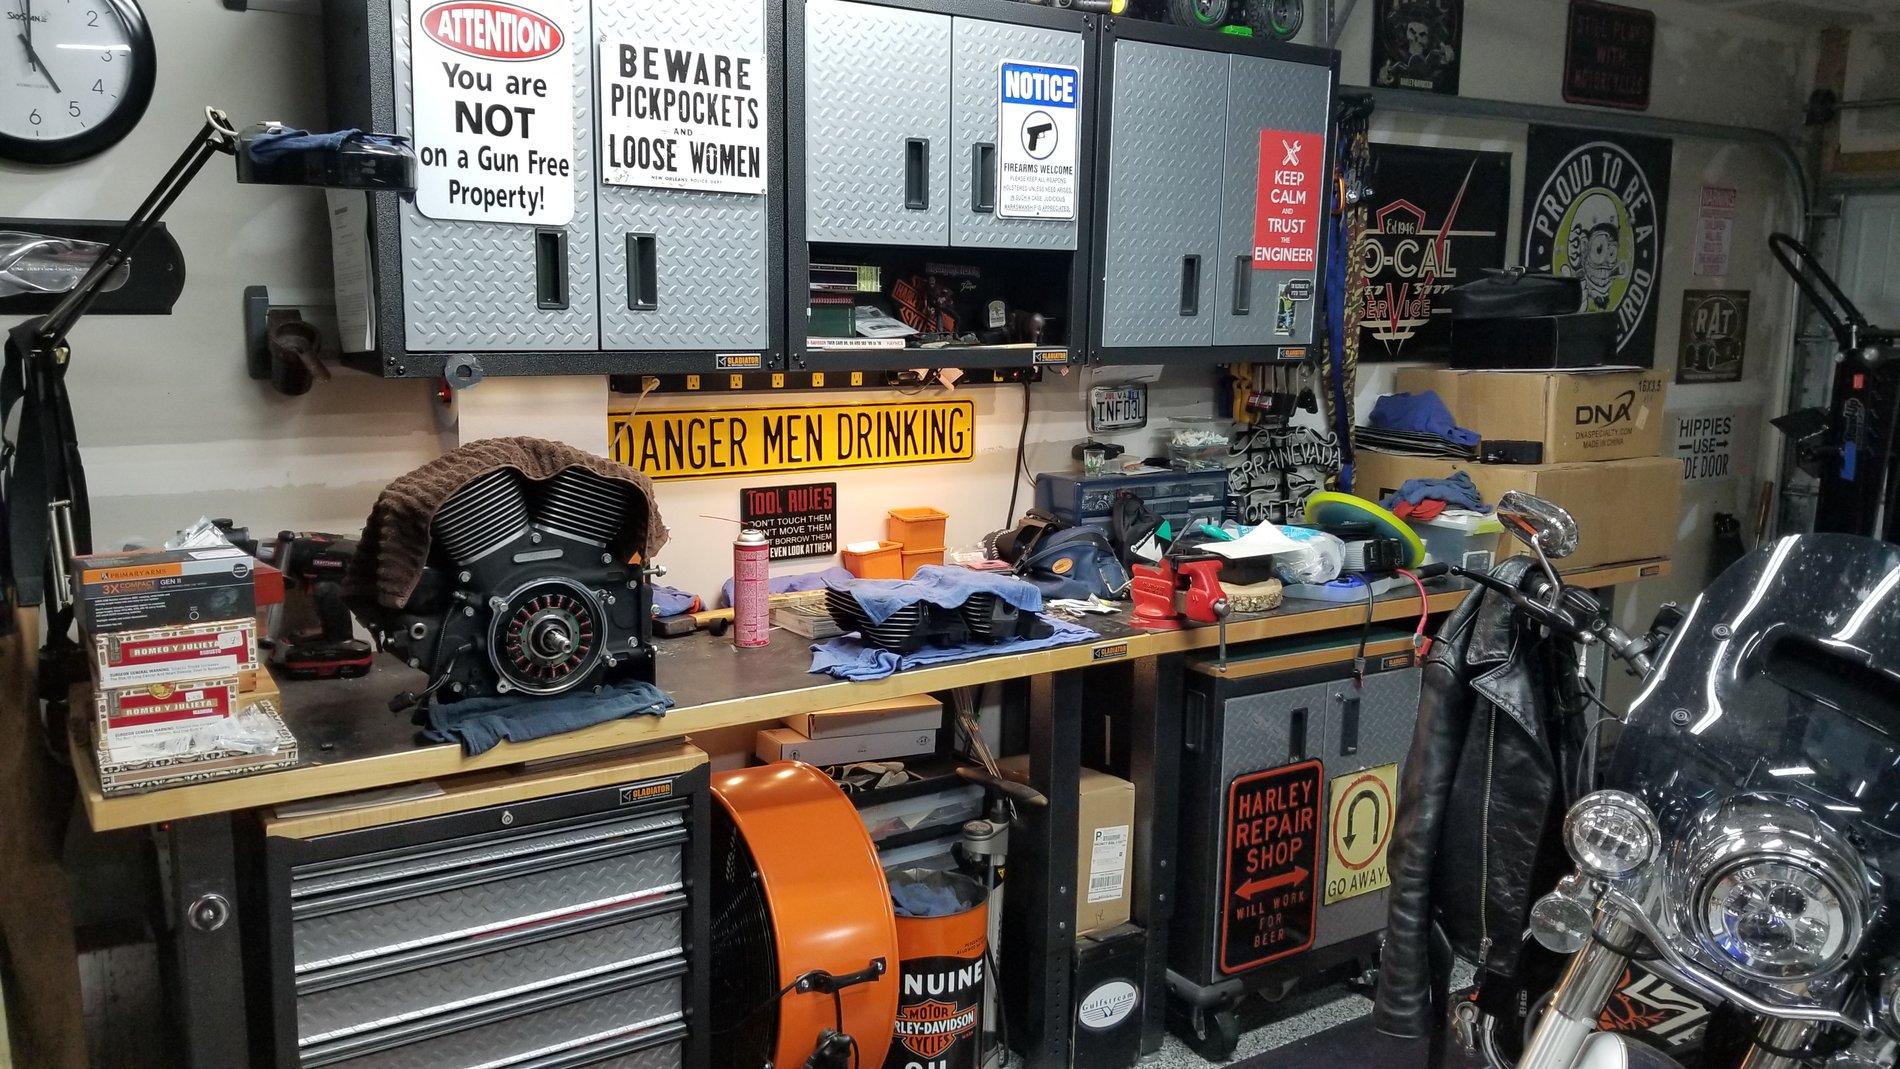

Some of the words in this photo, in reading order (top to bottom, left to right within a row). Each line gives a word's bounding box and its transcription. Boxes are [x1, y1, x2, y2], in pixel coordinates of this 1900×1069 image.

[86, 10, 99, 27] 2
[437, 7, 551, 52] ATTENTION
[619, 44, 751, 91] BEWARE
[92, 78, 104, 94] 4
[442, 62, 492, 92] You
[507, 75, 547, 98] are
[1005, 70, 1074, 103] NOTICE
[29, 108, 41, 125] 6
[69, 100, 81, 117] 5
[611, 84, 758, 129] PICKPOCKETS
[455, 100, 535, 139] NOT
[674, 128, 693, 137] AND
[420, 147, 447, 168] on
[458, 151, 469, 169] a
[478, 146, 519, 173] Gun
[529, 150, 570, 177] Free
[609, 134, 677, 172] LOOSE
[690, 141, 760, 178] WOMEN
[1004, 163, 1038, 173] FIREARMS
[1040, 165, 1073, 175] WELCOME
[1274, 170, 1305, 186] KEEP
[1602, 153, 1621, 188] TO
[449, 180, 545, 216] Property!
[1270, 189, 1307, 205] CALM
[1537, 154, 1593, 239] PROUD
[1626, 177, 1650, 223] BE
[1282, 207, 1294, 215] AND
[1268, 218, 1306, 234] TRUST
[1636, 224, 1653, 244] A
[1281, 236, 1291, 244] THE
[1254, 246, 1313, 262] ENGINEER
[1363, 238, 1456, 278] O-CAL
[1696, 303, 1734, 339] RAT
[1575, 398, 1633, 426] DNA
[1575, 428, 1633, 440] DNASPECIALTY.COM
[1679, 417, 1732, 437] HIPPIES
[613, 415, 747, 473] DANGER
[763, 414, 823, 465] MEN
[837, 407, 964, 461] DRINKING
[1583, 441, 1599, 449] MADE
[1606, 438, 1624, 446] CHINA
[1693, 438, 1715, 454] USE
[1279, 443, 1341, 469] NEVADA
[1701, 453, 1728, 478] DOOR
[747, 489, 782, 515] TOOL
[788, 487, 832, 512] RULES
[777, 516, 806, 525] TOUCH
[808, 513, 831, 522] THEM
[779, 525, 805, 535] MOVE
[808, 523, 832, 533] THEM
[775, 535, 810, 545] BORROW
[811, 533, 832, 541] THEM
[770, 546, 787, 558] EVEN
[788, 544, 804, 556] LOOK
[806, 543, 814, 555] AT
[815, 542, 832, 553] THEM
[111, 570, 144, 579] PRIMARY
[102, 584, 120, 595] 3X
[134, 646, 169, 656] ROMEO
[126, 706, 161, 716] ROMEO
[174, 700, 213, 710] JULIETA
[633, 784, 670, 797] GLADIATOR
[1239, 779, 1312, 819] HARLEY
[1236, 807, 1312, 849] REPAIR
[1246, 838, 1302, 873] SHOP
[1328, 877, 1346, 898] GO
[1236, 905, 1265, 921] WILL
[1273, 891, 1305, 910] WORK
[1259, 914, 1282, 930] FOR
[1254, 929, 1285, 948] BEER
[905, 958, 983, 995] NUINE
[909, 1003, 949, 1019] MOTOR
[1083, 992, 1133, 1010] Gulfstream
[895, 1011, 974, 1035] RLEY-DAVIDSON
[908, 1034, 950, 1054] CYCLES
